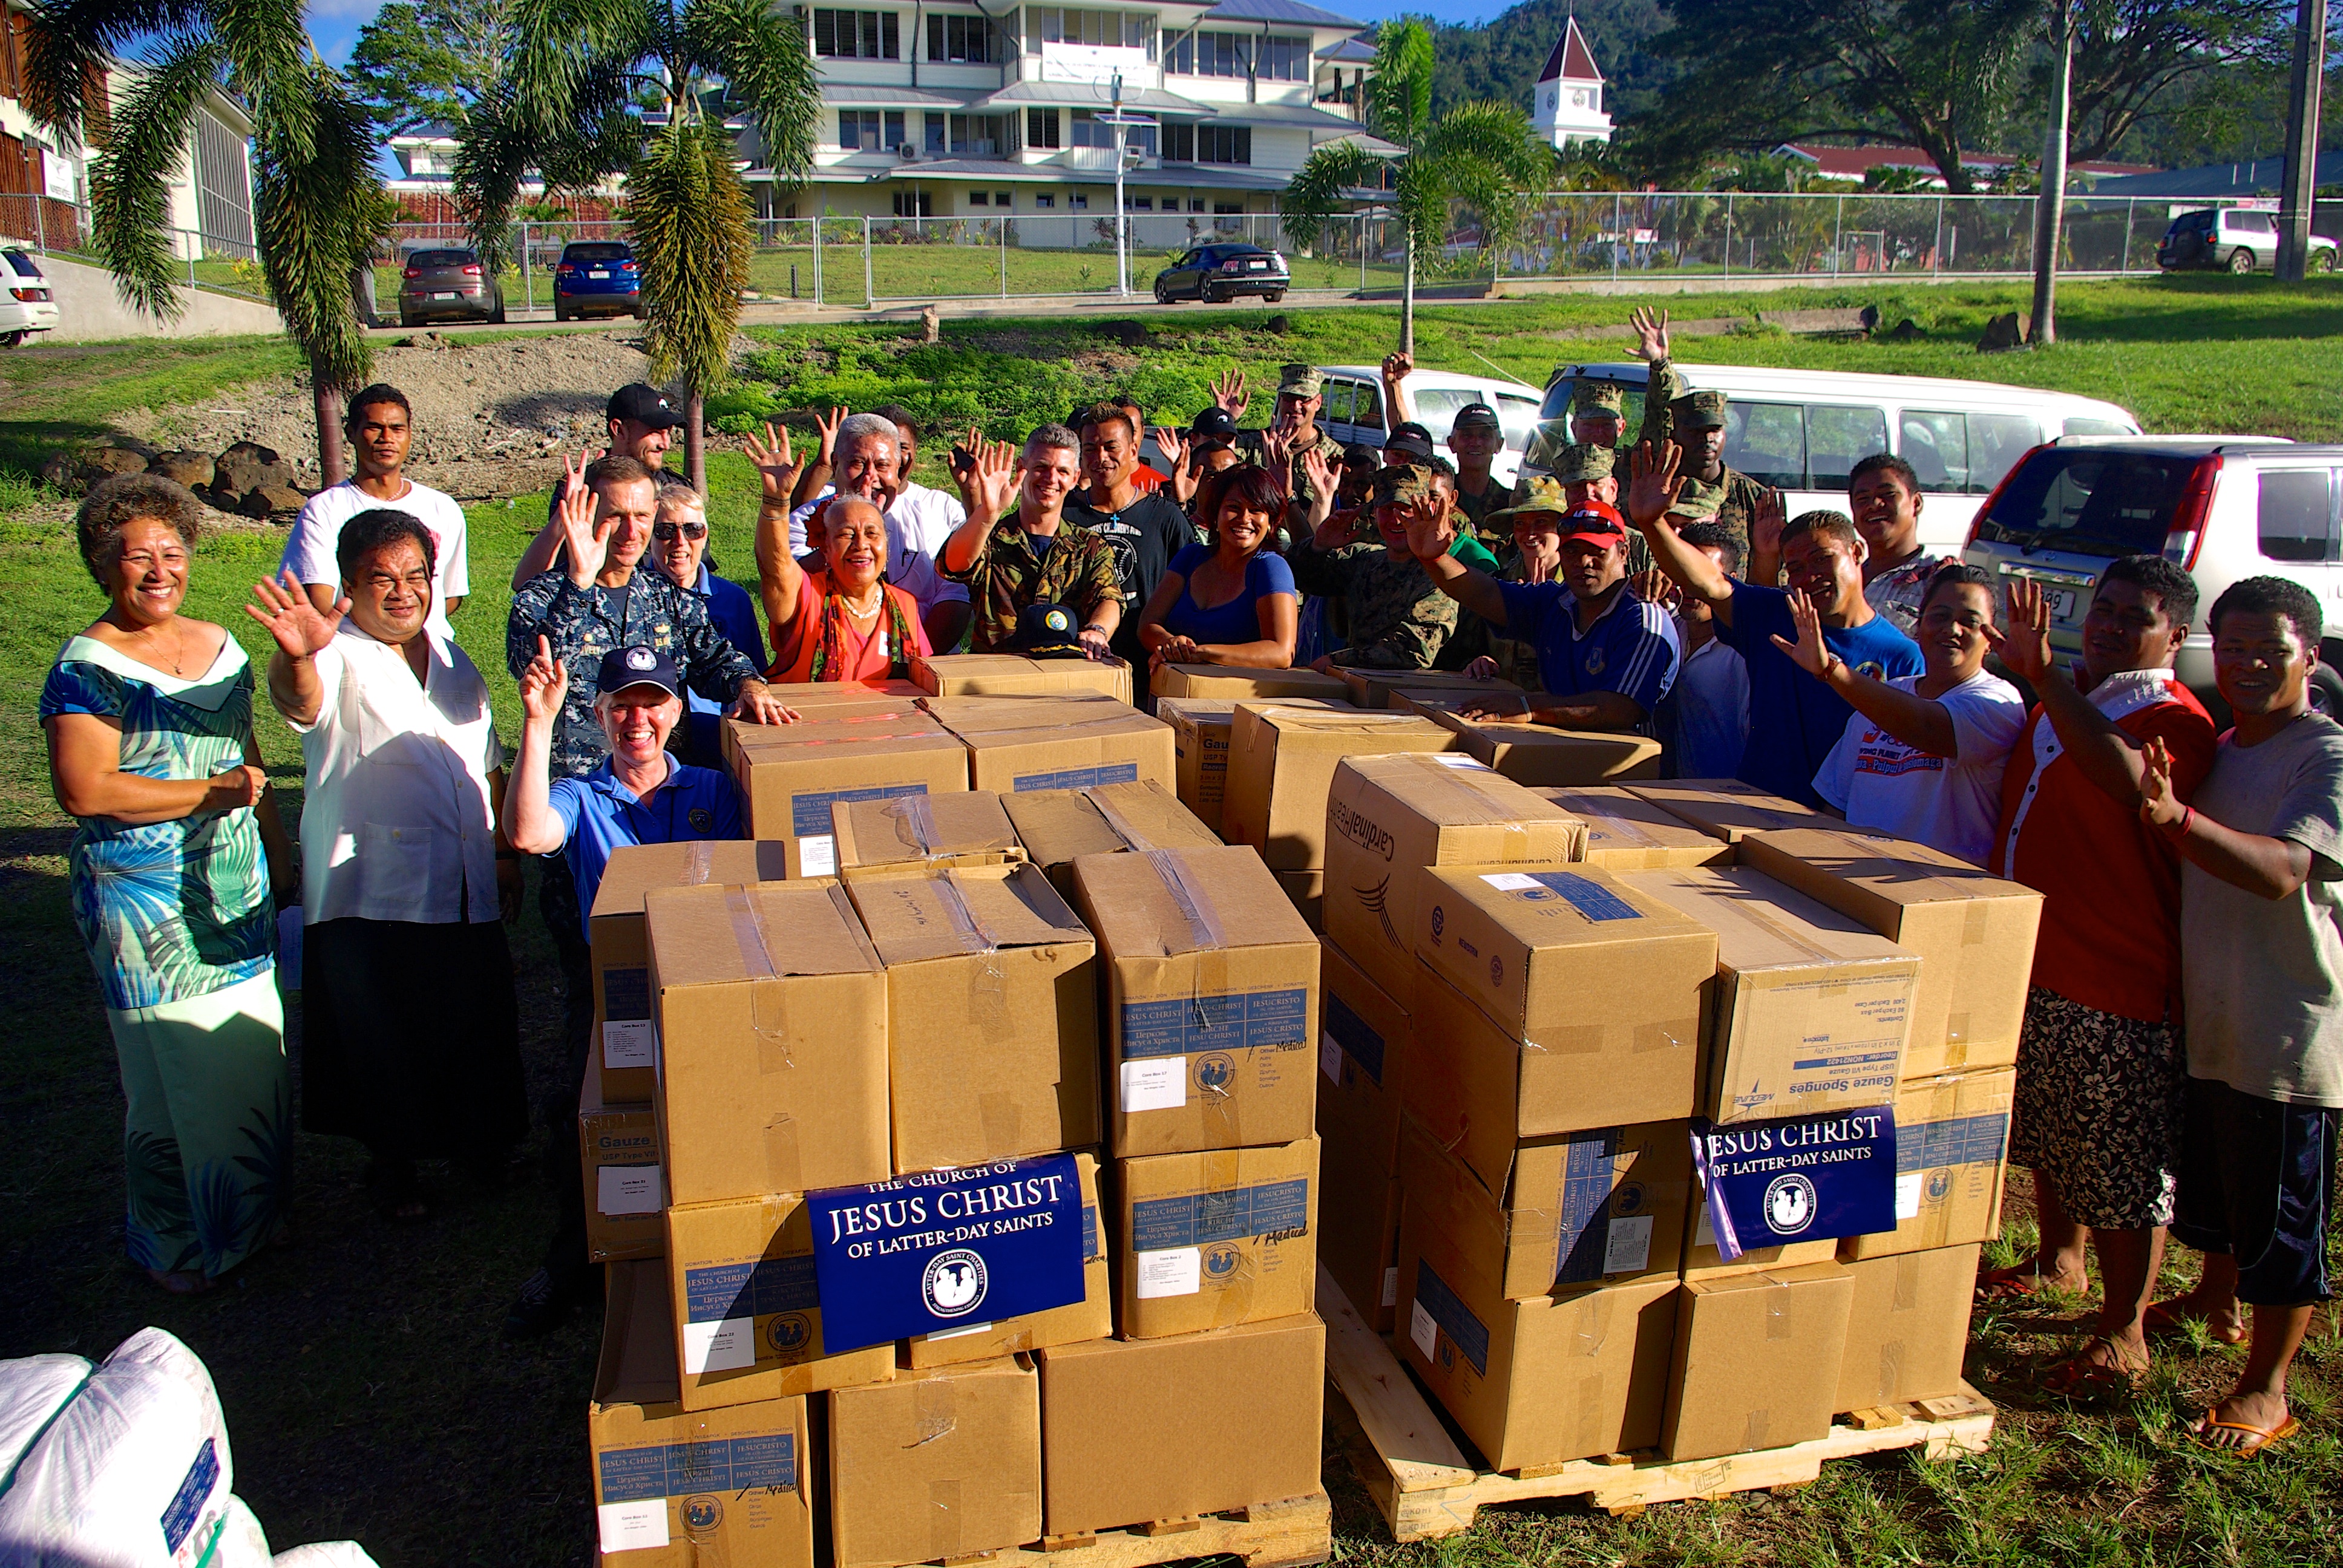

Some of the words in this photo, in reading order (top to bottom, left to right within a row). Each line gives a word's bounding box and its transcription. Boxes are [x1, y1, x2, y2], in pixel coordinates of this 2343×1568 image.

[1203, 738, 1229, 750] Gau
[1101, 769, 1134, 778] JESUCRISTO
[1032, 780, 1055, 788] CHRIST
[1253, 996, 1300, 1008] JESUCRISTO
[1122, 1013, 1147, 1022] JESUS
[1149, 1009, 1182, 1019] CHRIST
[1200, 1025, 1230, 1034] KIRCHE
[1250, 1027, 1273, 1036] JESUS
[1274, 1023, 1303, 1033] CRISTO
[1153, 1036, 1181, 1046] Христа
[1189, 1034, 1207, 1042] JESU
[1208, 1031, 1240, 1041] CHRISTI
[1276, 1036, 1308, 1053] Medical
[1813, 1046, 1833, 1055] 12-Ply
[1826, 1055, 1864, 1065] NON21422
[1867, 1051, 1897, 1061] Reorder:
[1828, 1067, 1851, 1075] Gauze
[1861, 1063, 1880, 1073] Type
[1789, 1079, 1849, 1094] Sponges
[1852, 1075, 1895, 1088] Gauze
[598, 1135, 651, 1148] Gauze
[1706, 1128, 1772, 1166] JESUS
[1779, 1115, 1882, 1148] CHRIST
[601, 1152, 620, 1161] USP
[622, 1152, 642, 1160] Type
[1712, 1163, 1729, 1178] OF
[1732, 1151, 1820, 1176] LATTER-DAY
[1821, 1146, 1872, 1163] SAINTS
[864, 1180, 904, 1194] THE
[908, 1165, 992, 1188] CHURCH
[993, 1161, 1018, 1175] OF
[1257, 1187, 1302, 1201] JESUCRISTO
[1766, 1178, 1784, 1213] LATTER-DAY
[828, 1196, 928, 1245] JESUS
[937, 1174, 1063, 1220] CHRIST
[1587, 1190, 1596, 1217] KIRCHE
[1133, 1210, 1158, 1219] JESUS
[1159, 1204, 1192, 1215] CHRIST
[1254, 1216, 1276, 1226] JESUS
[1277, 1210, 1305, 1221] CRISTO
[1215, 1222, 1246, 1233] CHRISTI
[1264, 1220, 1309, 1246] Medical
[847, 1241, 874, 1259] OF
[878, 1221, 991, 1256] LATTER-DAY
[993, 1211, 1054, 1235] SAINTS
[1163, 1229, 1190, 1240] Христа
[926, 1256, 946, 1295] LATTER-DAY
[945, 1252, 967, 1261] SAINT
[966, 1253, 985, 1285] CHARITIES
[687, 1278, 714, 1288] JESUS
[716, 1273, 753, 1284] CHRIST
[736, 1440, 787, 1453] JESUCRISTO
[601, 1460, 628, 1469] JESUS
[628, 1455, 664, 1466] CHRIST
[692, 1474, 726, 1484] CHRISTI
[735, 1469, 759, 1480] JESUS
[761, 1466, 793, 1476] CRISTO
[635, 1480, 664, 1489] Христа
[764, 1480, 798, 1497] Medical
